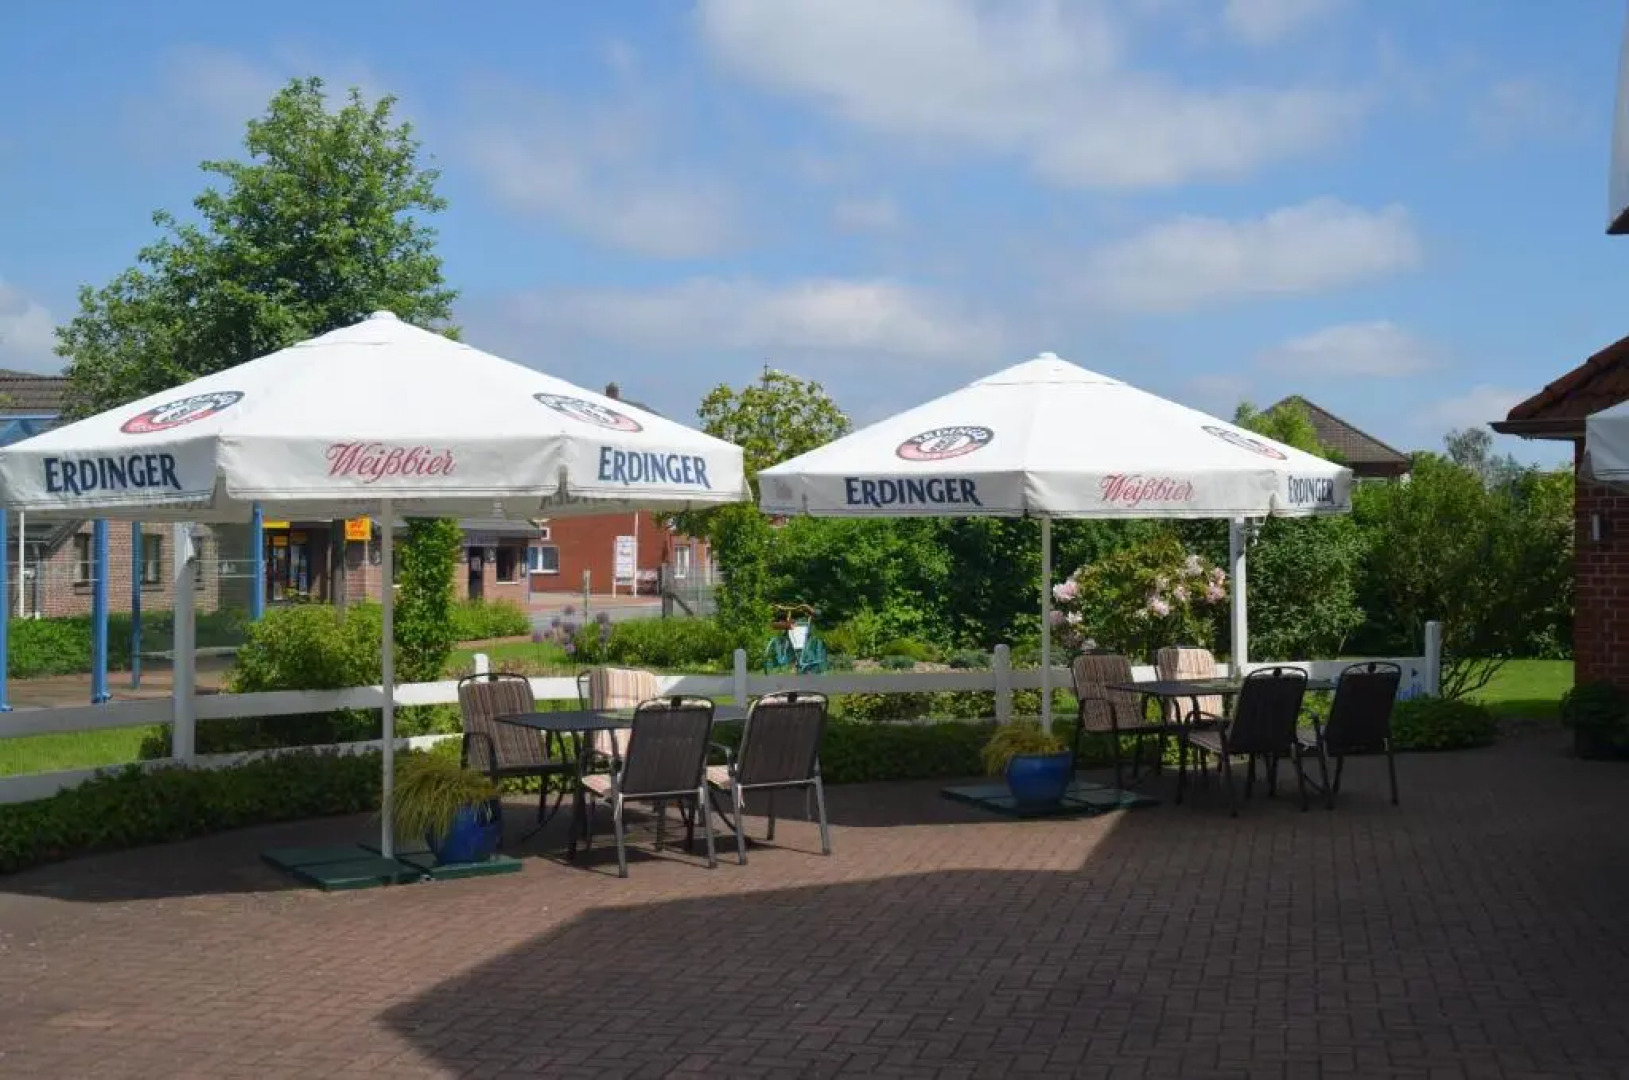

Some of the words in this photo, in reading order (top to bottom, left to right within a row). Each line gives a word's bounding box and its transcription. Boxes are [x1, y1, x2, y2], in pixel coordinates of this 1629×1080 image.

[43, 453, 182, 494] ERDINGER
[325, 442, 457, 484] Weißbier
[598, 446, 712, 489] ERDINGER
[844, 476, 983, 507] ERDINGER
[1100, 473, 1195, 508] Weißbier
